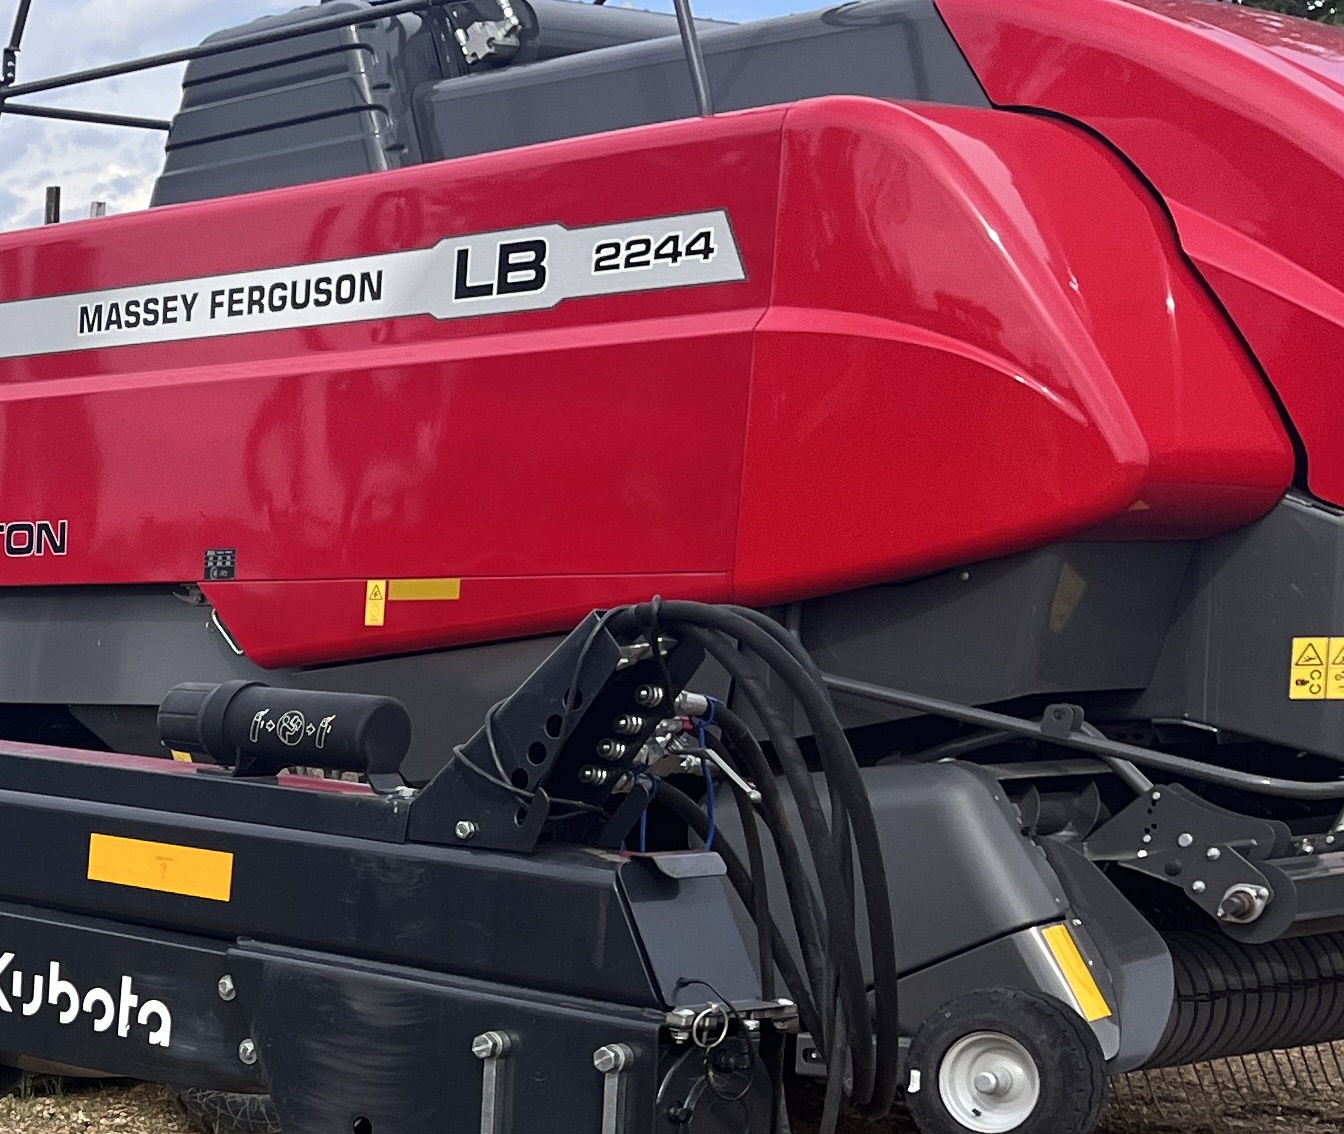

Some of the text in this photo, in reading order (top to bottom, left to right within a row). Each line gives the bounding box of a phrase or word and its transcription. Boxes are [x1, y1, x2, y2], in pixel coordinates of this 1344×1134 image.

[78, 229, 716, 335] MASSEY FERGUSON LB 2244
